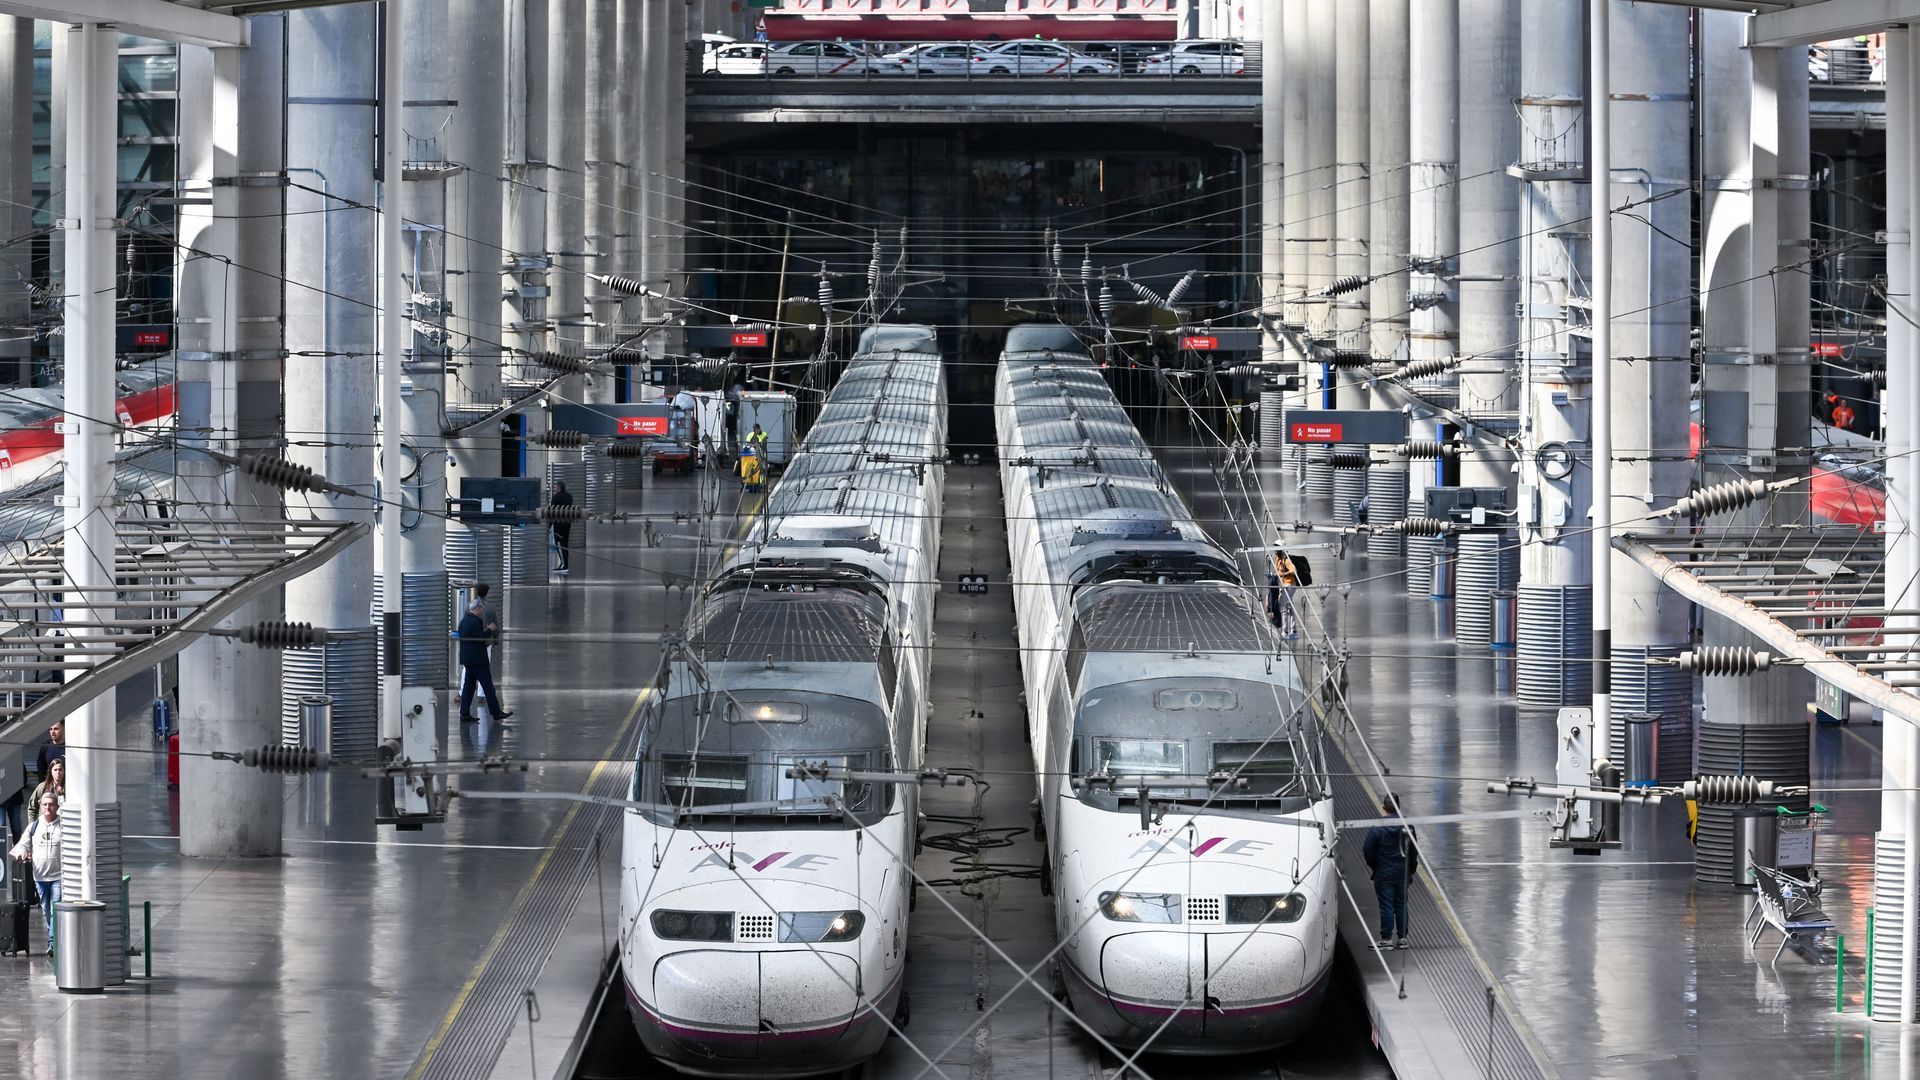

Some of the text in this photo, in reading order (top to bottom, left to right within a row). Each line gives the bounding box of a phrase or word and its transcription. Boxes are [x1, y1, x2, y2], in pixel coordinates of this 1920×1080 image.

[1127, 828, 1174, 838] renfe
[689, 841, 736, 851] renfe
[1128, 837, 1274, 859] AVE
[688, 851, 839, 873] AVE
